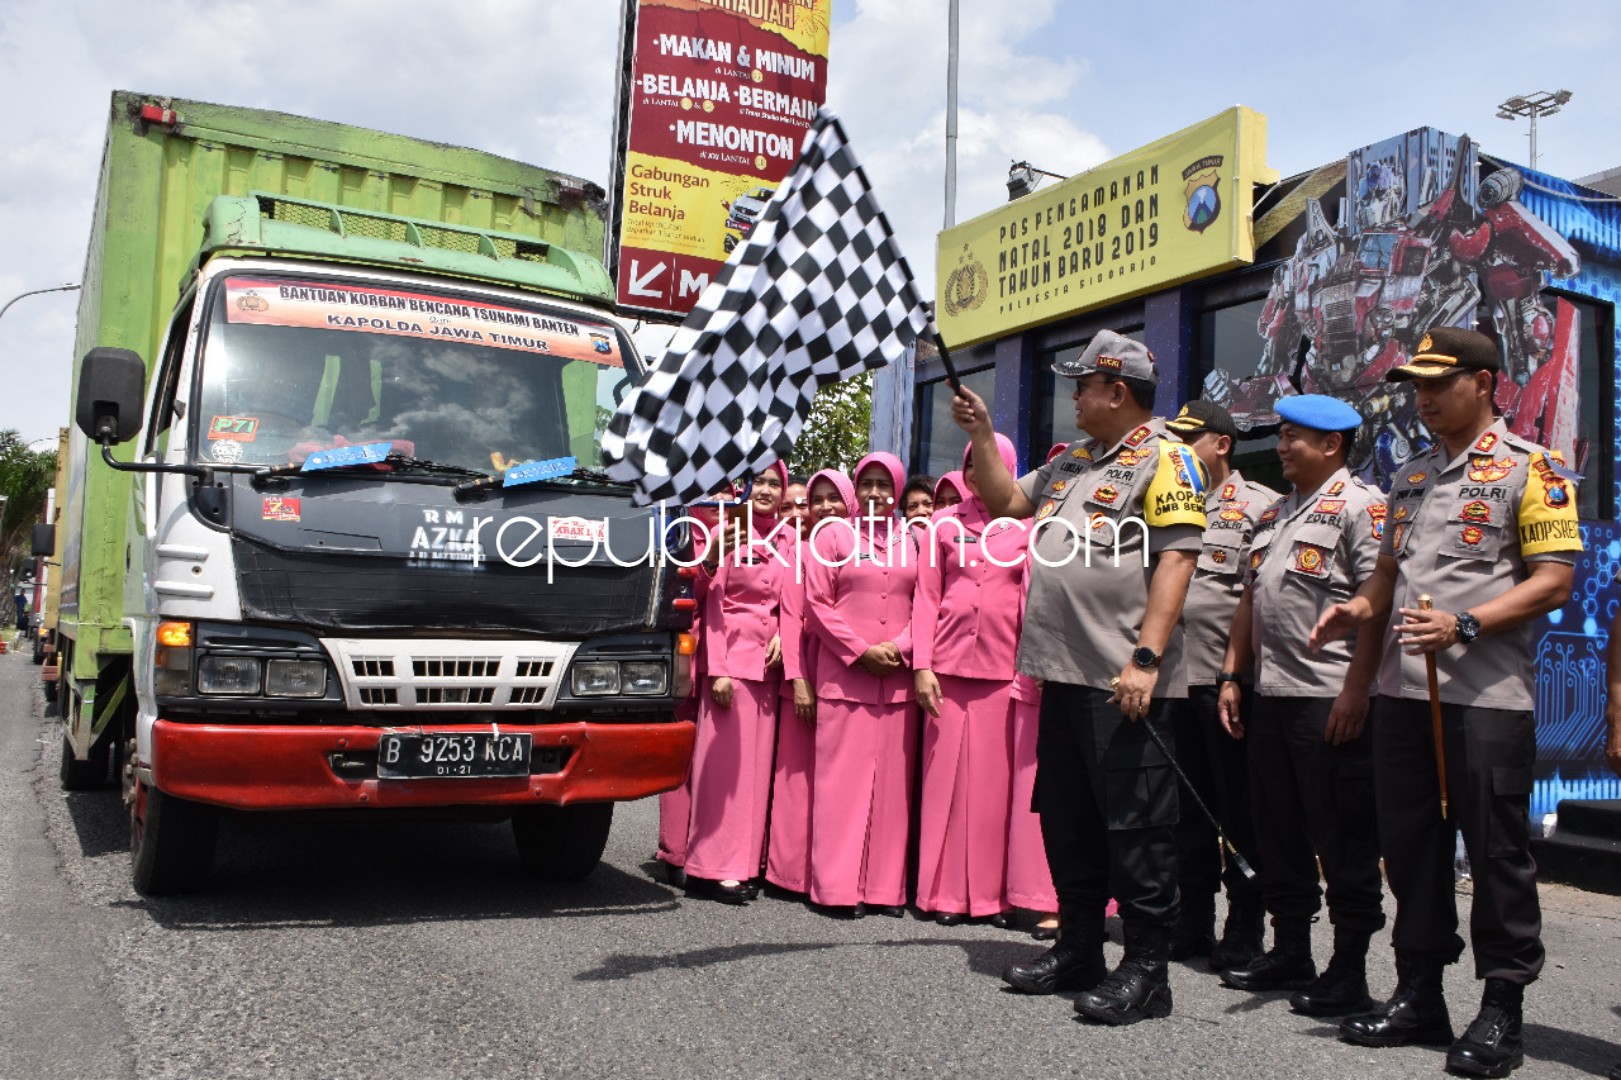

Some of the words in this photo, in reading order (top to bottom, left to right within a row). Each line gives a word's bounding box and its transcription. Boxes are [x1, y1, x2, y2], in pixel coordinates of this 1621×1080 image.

[659, 33, 731, 64] MAKAN
[737, 45, 750, 68] &
[756, 49, 815, 82] MINUM
[643, 73, 730, 103] BELANJA
[739, 85, 818, 121] BERMAIN
[677, 119, 793, 159] MENONTON
[630, 182, 672, 200] Struk
[631, 164, 710, 188] Gabungan
[629, 200, 685, 222] Belanja
[1000, 217, 1028, 244] POS
[1036, 164, 1159, 231] PENGAMANAN
[999, 235, 1050, 273] NATAL
[1063, 213, 1106, 250] 2018
[1121, 193, 1158, 229] DAN
[999, 261, 1050, 298] TAHUN
[1058, 242, 1104, 279] BARU
[1112, 222, 1158, 260] 2019
[1000, 284, 1069, 314] POLRESTA
[1080, 256, 1155, 289] SIDOARJO
[279, 285, 347, 304] BANTUAN
[350, 293, 406, 310] KORBAN
[409, 299, 470, 317] BENCANA
[472, 307, 530, 328] TSUNAMI
[532, 317, 579, 335] BANTEN
[327, 315, 423, 333] KAPOLDA
[429, 325, 484, 341] JAWA
[489, 332, 548, 350] TIMUR
[1104, 469, 1134, 481] POLRI
[1458, 487, 1507, 500] POLRI
[1155, 502, 1179, 516] OMB
[1306, 513, 1343, 529] POLRI
[1210, 521, 1242, 529] POLRI
[386, 738, 400, 763] B
[420, 736, 476, 763] 9253
[485, 736, 523, 761] KCA
